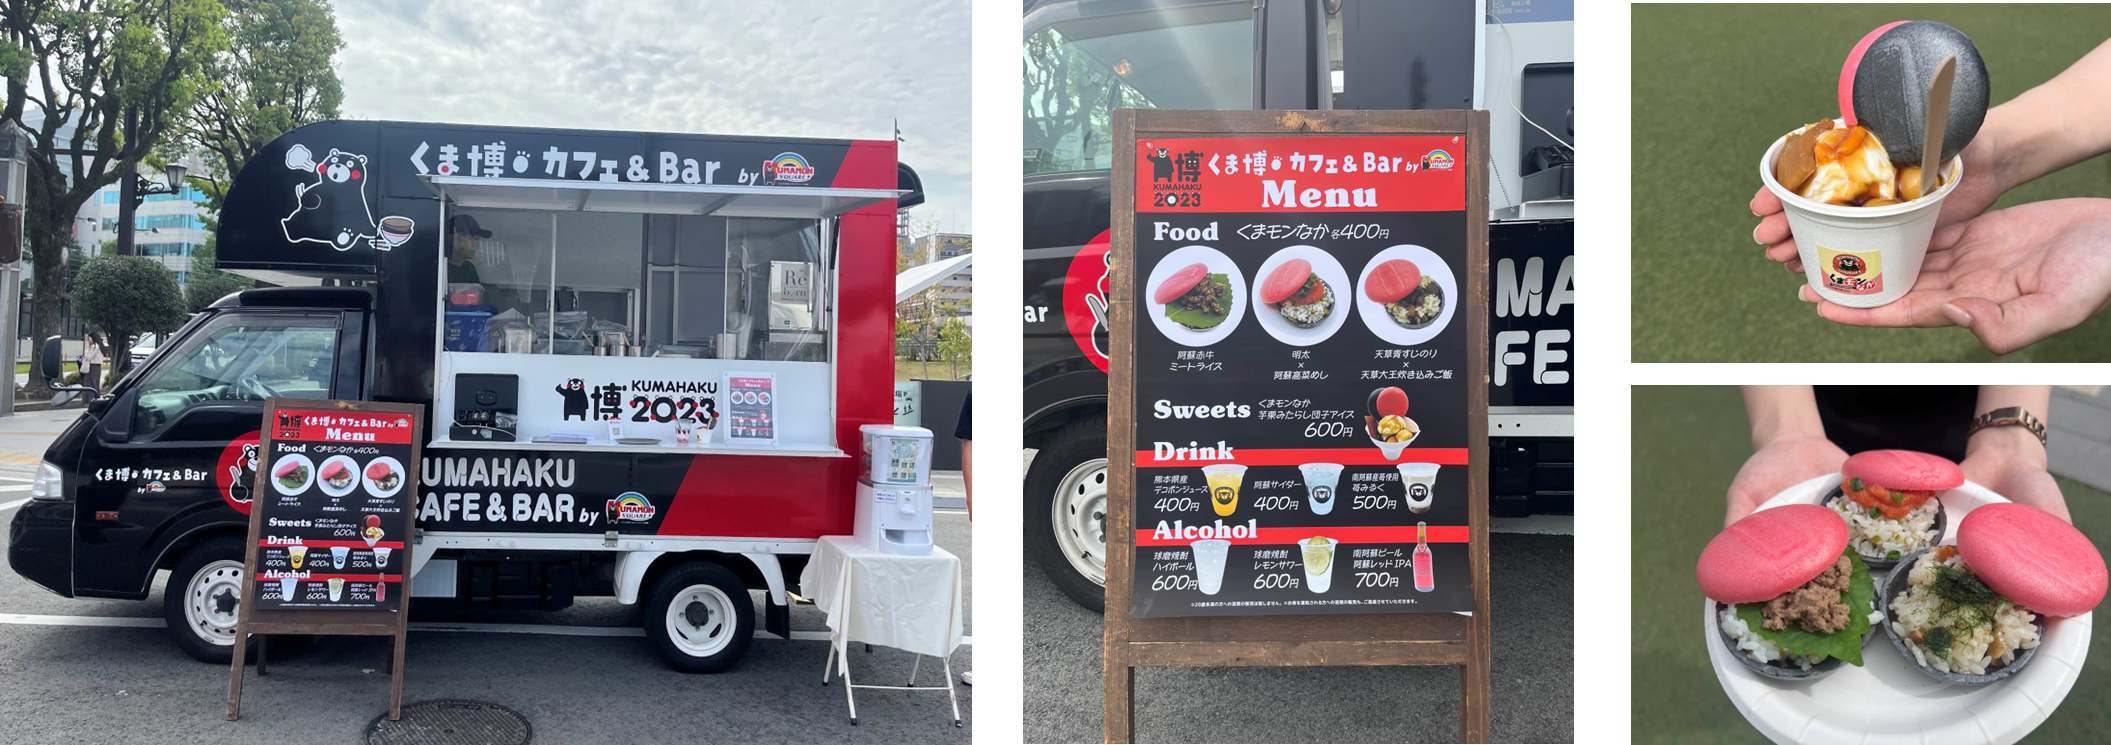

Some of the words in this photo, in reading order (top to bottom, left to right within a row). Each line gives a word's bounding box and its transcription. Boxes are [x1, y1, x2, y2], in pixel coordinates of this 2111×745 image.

[1208, 150, 1267, 176] くま博
[1363, 152, 1402, 173] Bar
[1405, 161, 1419, 174] by
[659, 151, 721, 185] Bar
[738, 168, 759, 186] by
[1153, 183, 1202, 191] KUMAHAKU
[1261, 179, 1378, 208] Menu
[1153, 191, 1202, 208] 2023
[1153, 221, 1219, 241] Food
[1177, 350, 1215, 360] 阿蘇赤牛
[1292, 350, 1311, 359] 明太
[1374, 349, 1438, 359] 天草青すじのり
[1170, 362, 1223, 371] ミートライス
[1274, 370, 1329, 380] 阿蘇高菜めし
[1360, 370, 1453, 380] 天草大王炊き込みご飯
[631, 380, 718, 394] KUMAHAKU
[1153, 399, 1251, 419] Sweets
[1258, 399, 1312, 409] くまモンなか
[629, 394, 720, 425] 2023
[1258, 410, 1355, 420] 芋栗みたらし団子アイス
[370, 418, 387, 428] Bar
[325, 427, 376, 441] Menu
[1304, 421, 1354, 438] 600円
[279, 431, 300, 439] 2023
[277, 443, 306, 453] Food
[1153, 440, 1235, 461] Drink
[95, 467, 130, 481] くま博
[184, 468, 208, 481] Bar
[420, 457, 575, 488] UMAHAKU
[1154, 475, 1188, 484] 熊本県産
[1154, 485, 1209, 494] デコポンジュース
[1253, 480, 1302, 490] 阿蘇サイダー
[1154, 497, 1200, 512] 400円
[1253, 496, 1299, 511] 400円
[1352, 495, 1397, 510] 500円
[417, 492, 481, 522] AFE
[512, 492, 575, 523] BAR
[579, 508, 600, 526] by
[269, 517, 312, 527] Sweets
[1152, 518, 1258, 540] Alcohol
[267, 535, 303, 545] Drink
[1153, 551, 1189, 561] 球磨焼酎
[1253, 550, 1288, 559] 球磨焼酎
[1352, 548, 1403, 558] 南阿蘇ビール
[1152, 562, 1195, 572] ハイボール
[1254, 561, 1303, 570] レモンサワー
[264, 569, 310, 579] Alcohol
[1151, 575, 1198, 591] 600円
[1253, 573, 1299, 590] 600円
[1354, 572, 1399, 588] 700円
